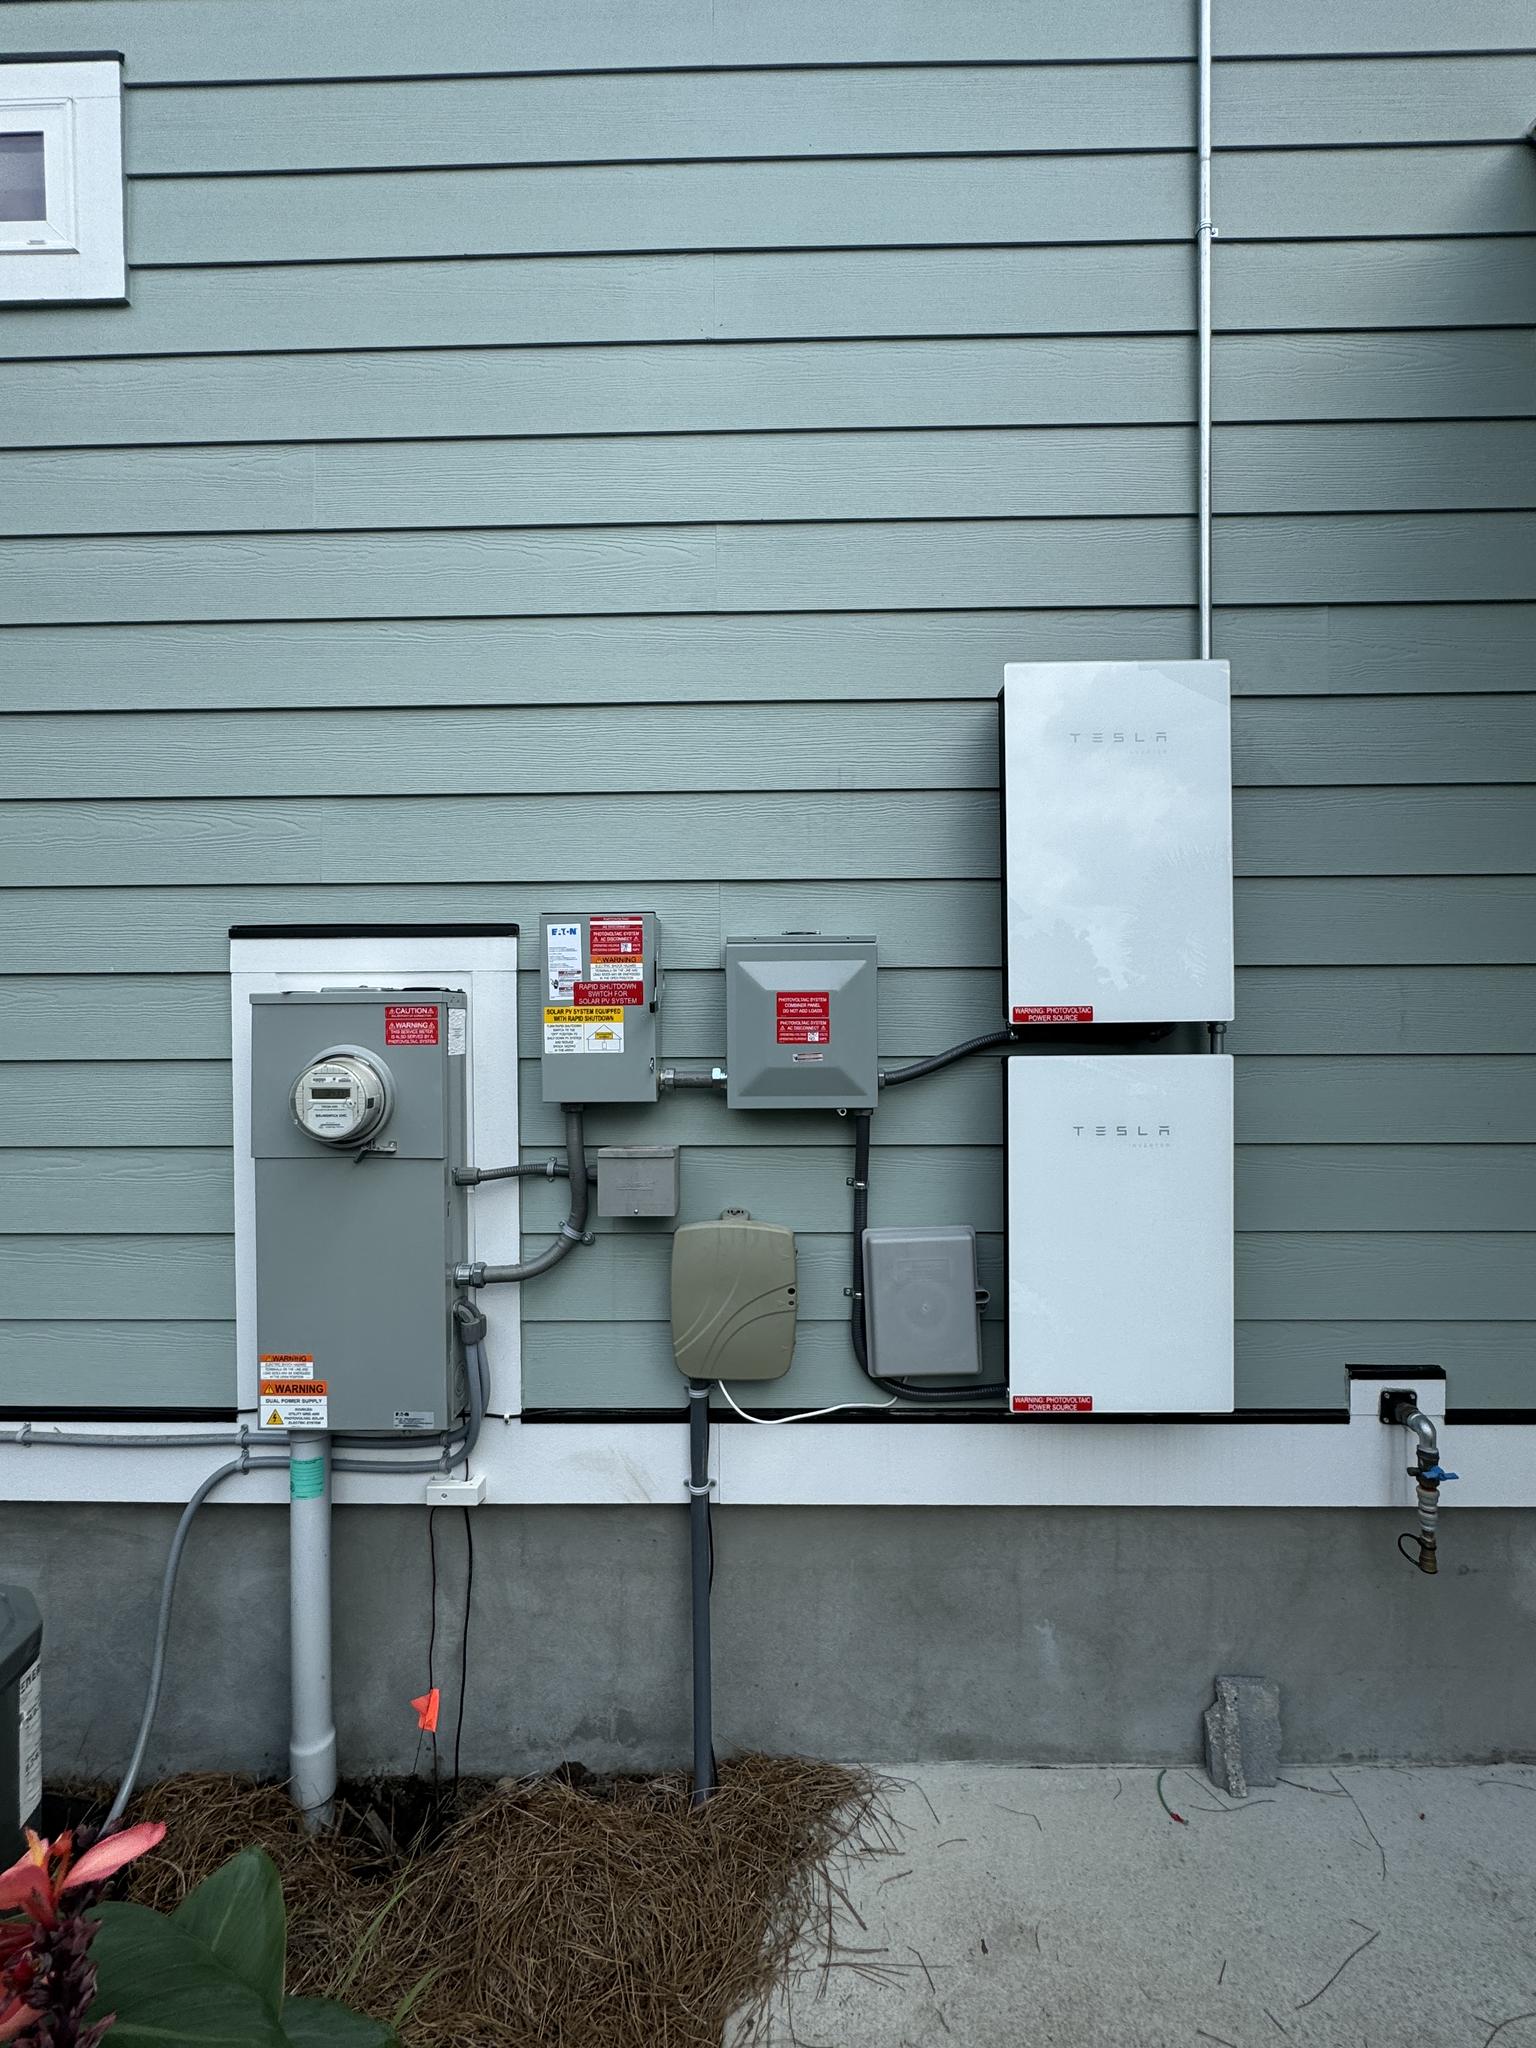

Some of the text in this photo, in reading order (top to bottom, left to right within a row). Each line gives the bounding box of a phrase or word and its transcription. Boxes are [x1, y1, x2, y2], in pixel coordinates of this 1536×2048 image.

[1070, 732, 1167, 743] TESLA
[1073, 1126, 1170, 1136] TESLA
[275, 1385, 324, 1393] WARNING
